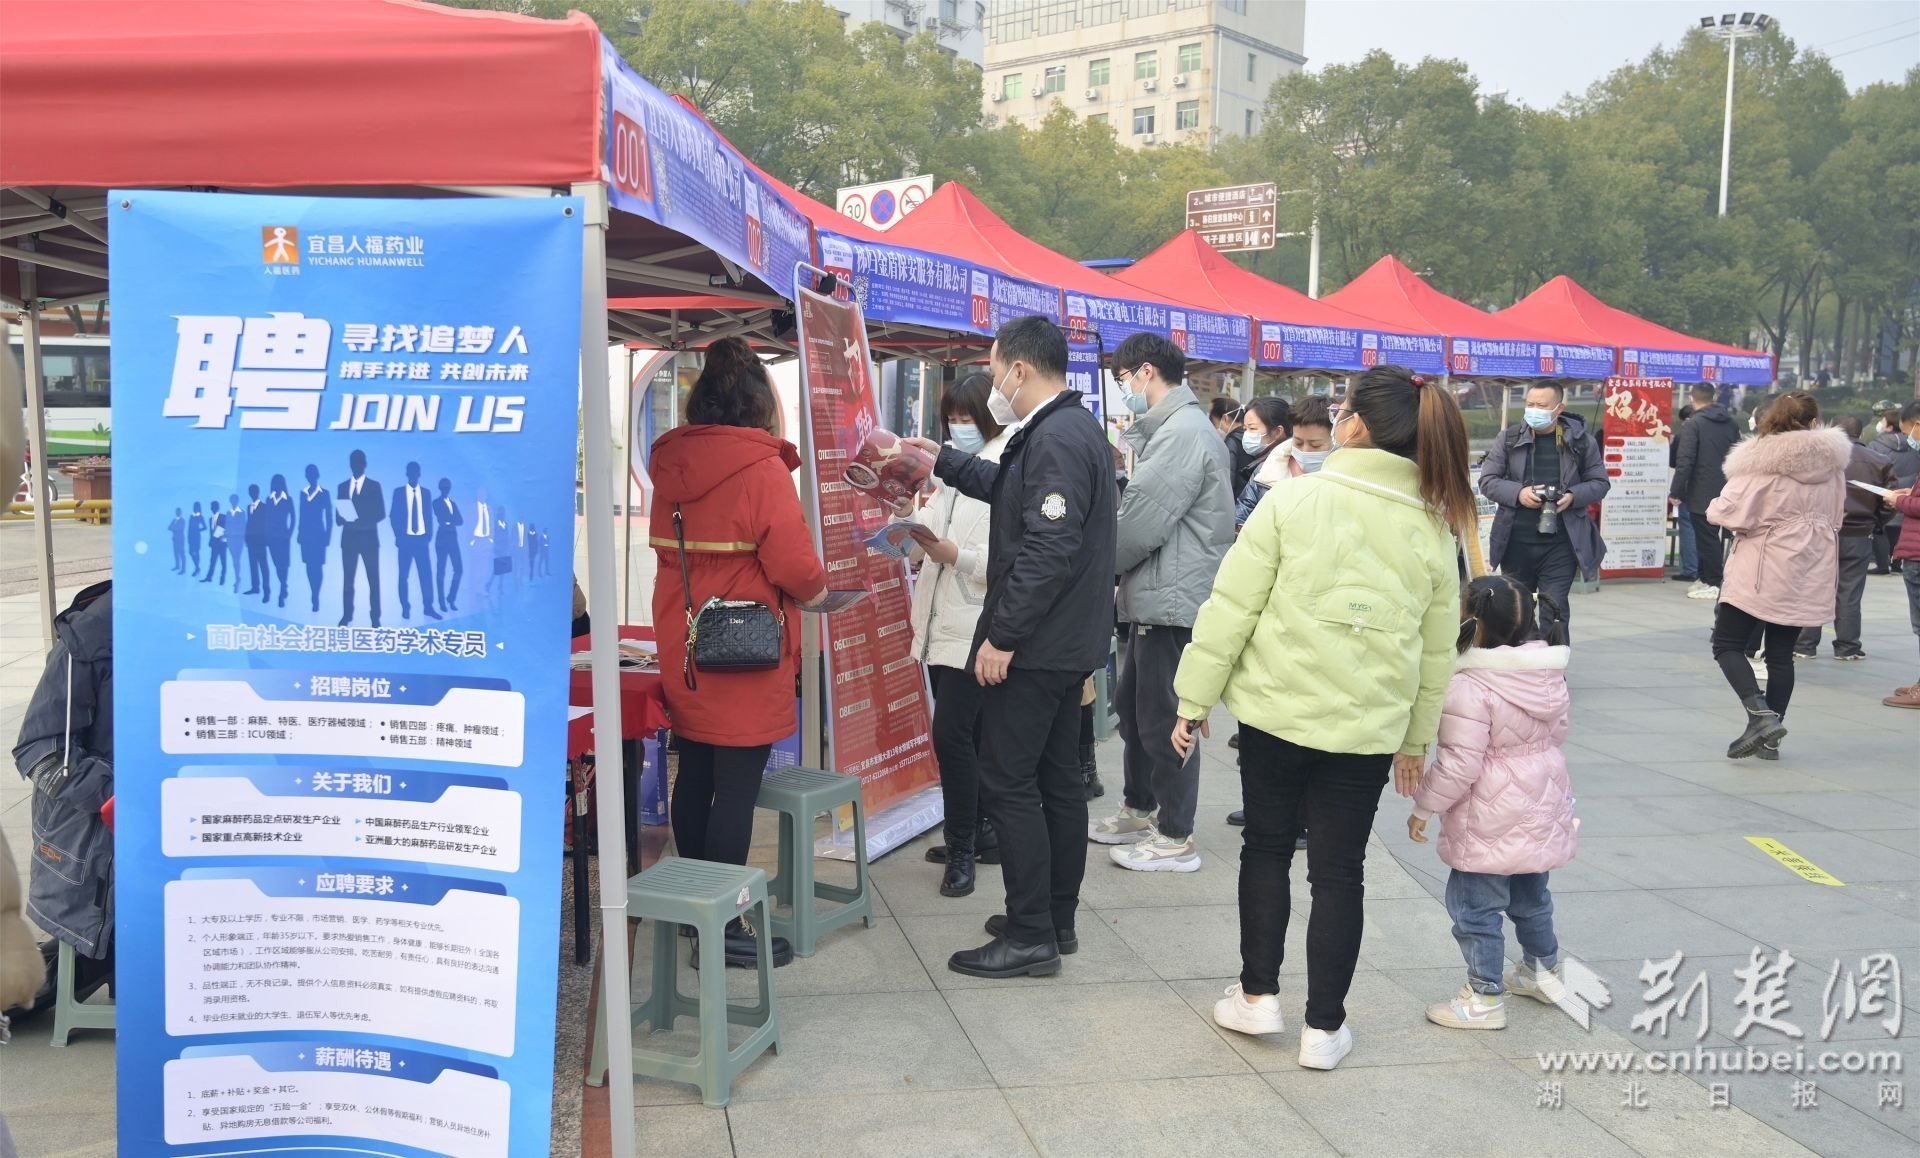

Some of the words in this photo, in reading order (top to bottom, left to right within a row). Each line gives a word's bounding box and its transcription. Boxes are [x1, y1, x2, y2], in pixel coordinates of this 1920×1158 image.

[616, 123, 648, 195] 001
[846, 204, 861, 219] 30
[307, 234, 425, 255] 宜昌人福药业
[263, 265, 300, 276] 人福医药
[308, 256, 355, 267] YICHANG
[357, 257, 425, 268] HUMANWELL
[972, 298, 989, 325] 004
[341, 323, 529, 355] 寻找追梦人
[1264, 342, 1281, 360] 007
[1362, 349, 1377, 366] 008
[1454, 355, 1469, 370] 009
[162, 311, 332, 430] 聘
[339, 361, 431, 381] 携手并进
[440, 362, 529, 382] 共创未来
[1541, 358, 1553, 372] 010
[1624, 363, 1637, 377] 011
[1703, 366, 1715, 380] 012
[328, 394, 441, 432] JOIN
[454, 395, 527, 433] US
[206, 624, 487, 657] 面向社会招聘医药学术专员
[310, 675, 391, 698] 招聘岗位
[312, 771, 392, 794] 关于我们
[201, 814, 341, 825] 国家麻醉药品定点研发生产企业
[365, 817, 489, 837] 中国麻醉药品生产行业领军企业
[201, 832, 303, 843] 国家重点高新技术企业
[365, 834, 497, 856] 亚洲最大的麻醉药品研发生产企业
[316, 872, 394, 895] 应聘要求
[315, 1046, 392, 1072] 薪酬待遇
